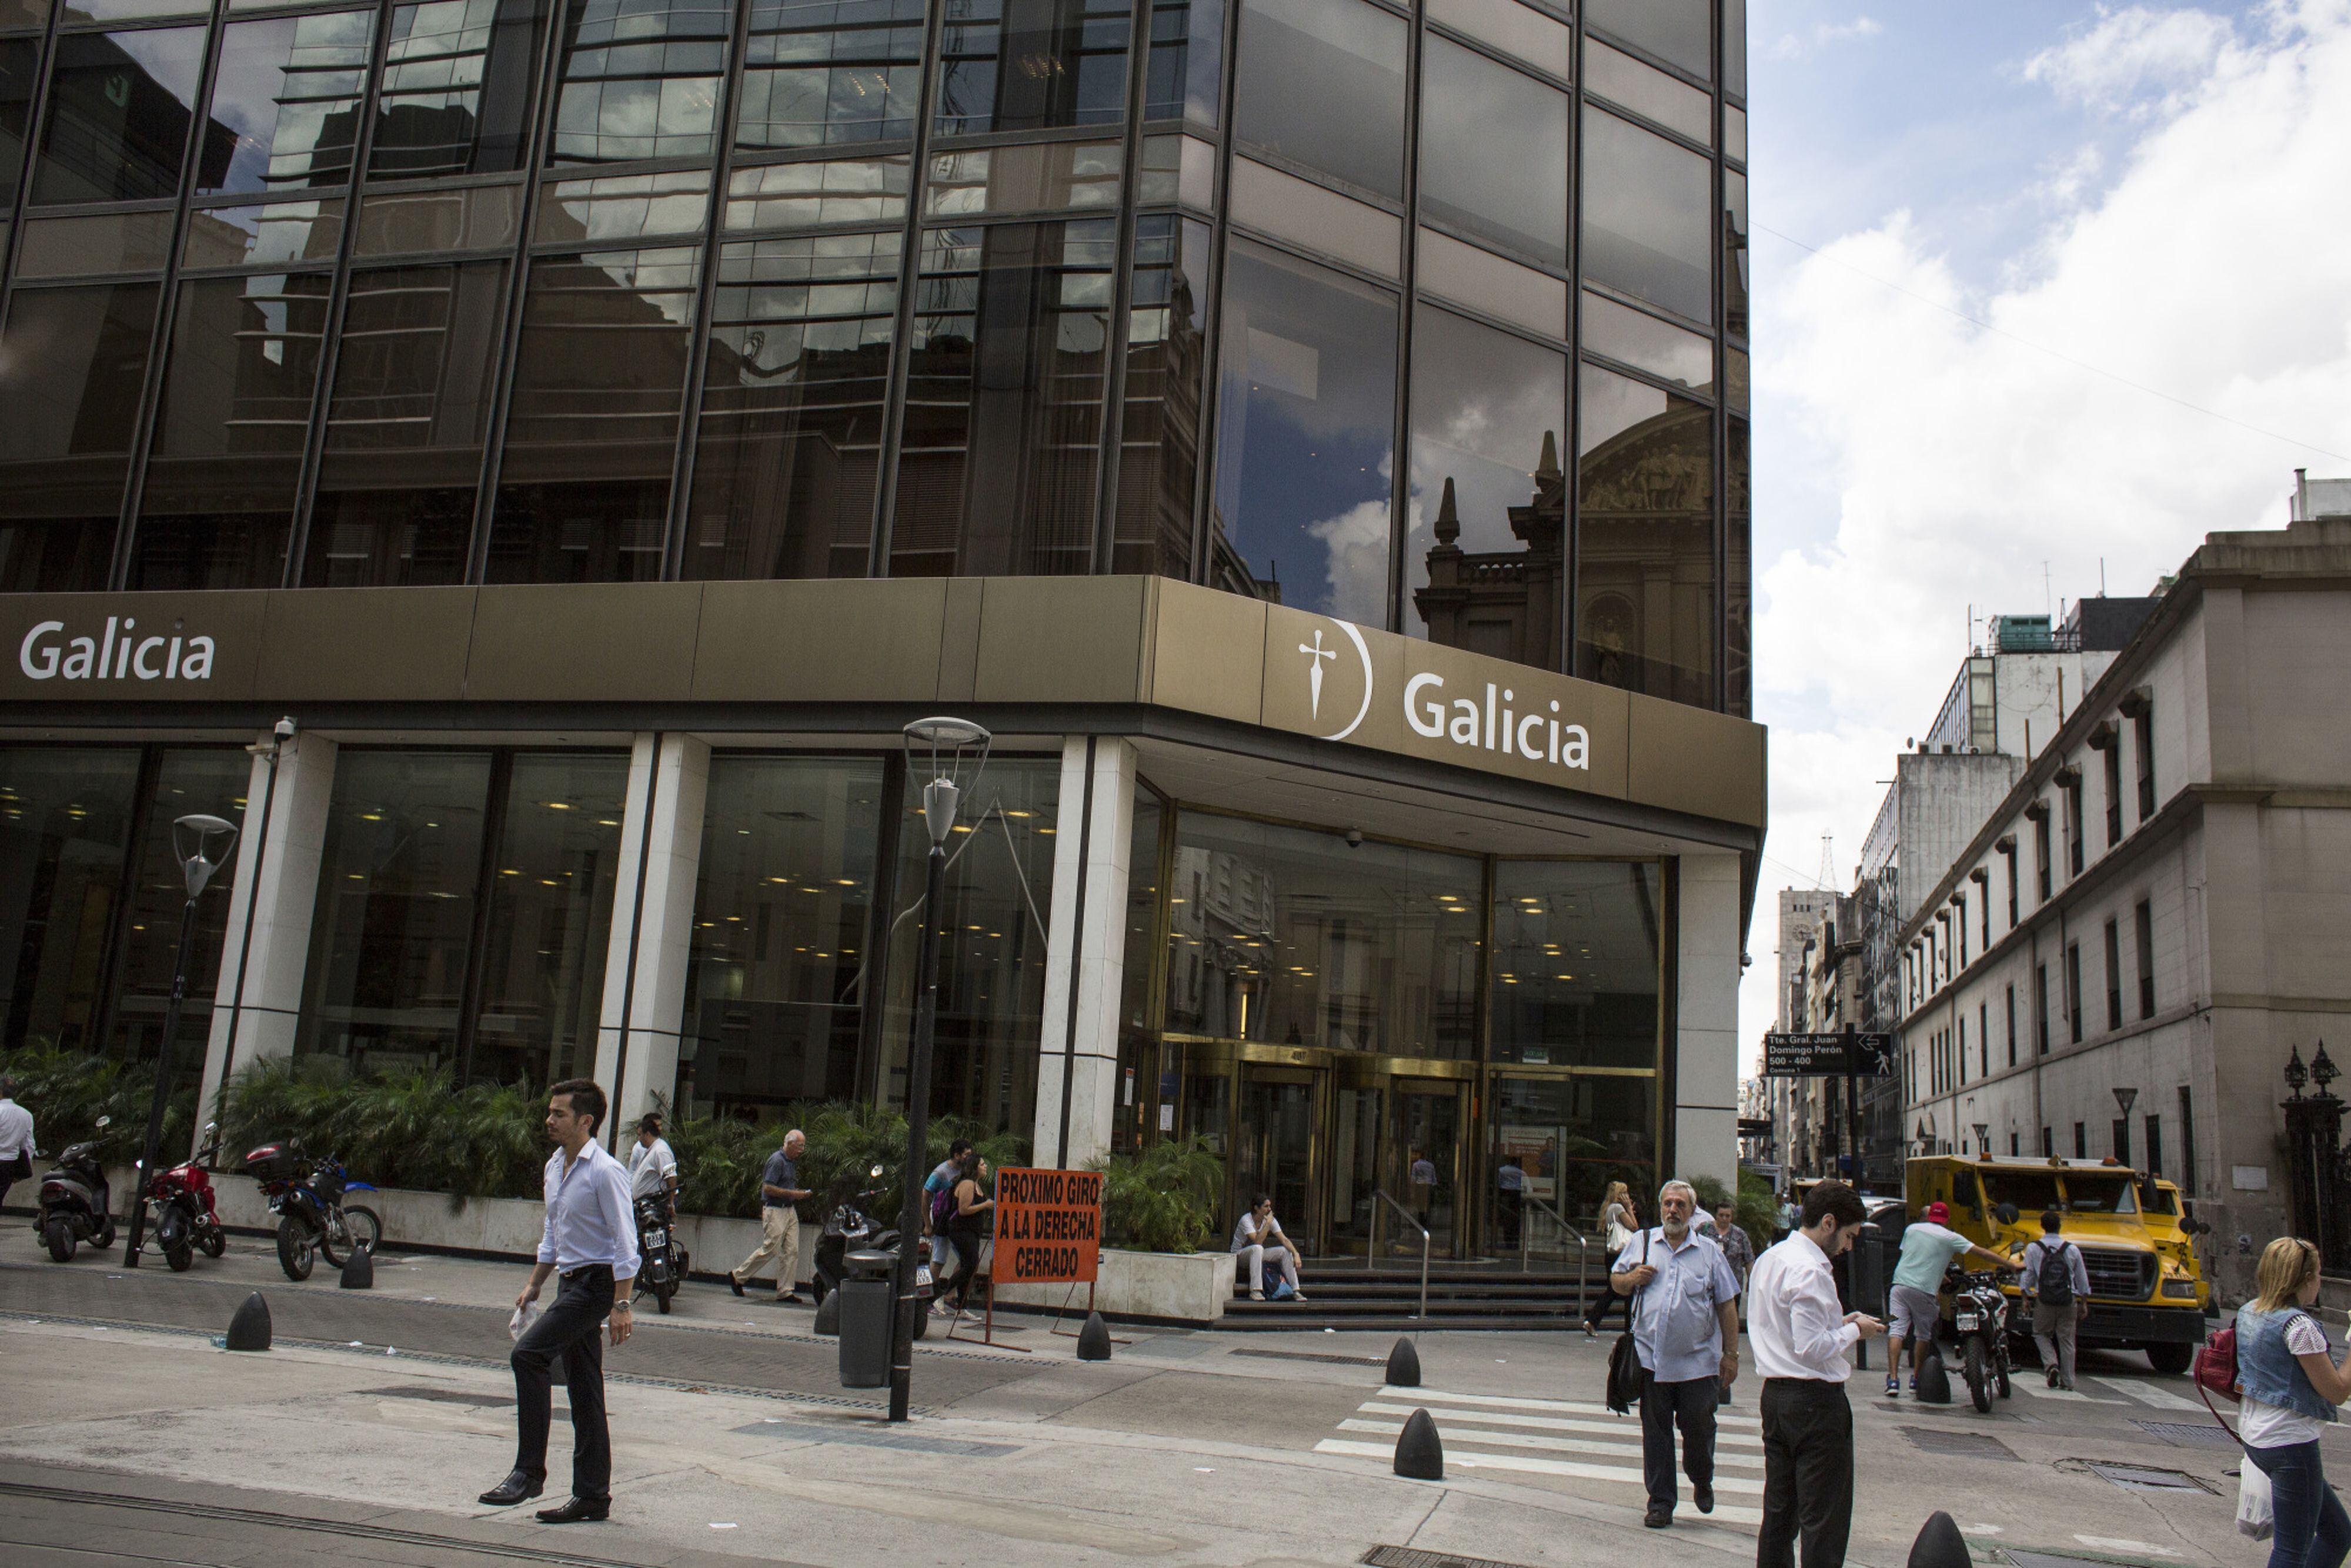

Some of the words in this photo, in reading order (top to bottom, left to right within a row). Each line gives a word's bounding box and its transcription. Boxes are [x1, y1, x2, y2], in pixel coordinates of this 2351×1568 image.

[19, 617, 215, 680] Galicia
[1404, 672, 1589, 771] Galicia
[1769, 1046, 1812, 1055] Domingo
[1815, 1045, 1842, 1054] Perón
[1789, 1035, 1811, 1044] Gral.
[1815, 1035, 1837, 1044] Juan
[1769, 1057, 1786, 1065] 500
[1794, 1057, 1811, 1065] 400
[1000, 1172, 1063, 1205] PROXIMO
[1067, 1175, 1099, 1206] GIRO
[999, 1211, 1009, 1239] A
[1014, 1210, 1030, 1240] LA
[1035, 1210, 1095, 1241] DERECHA
[1016, 1246, 1078, 1278] CERRADO
